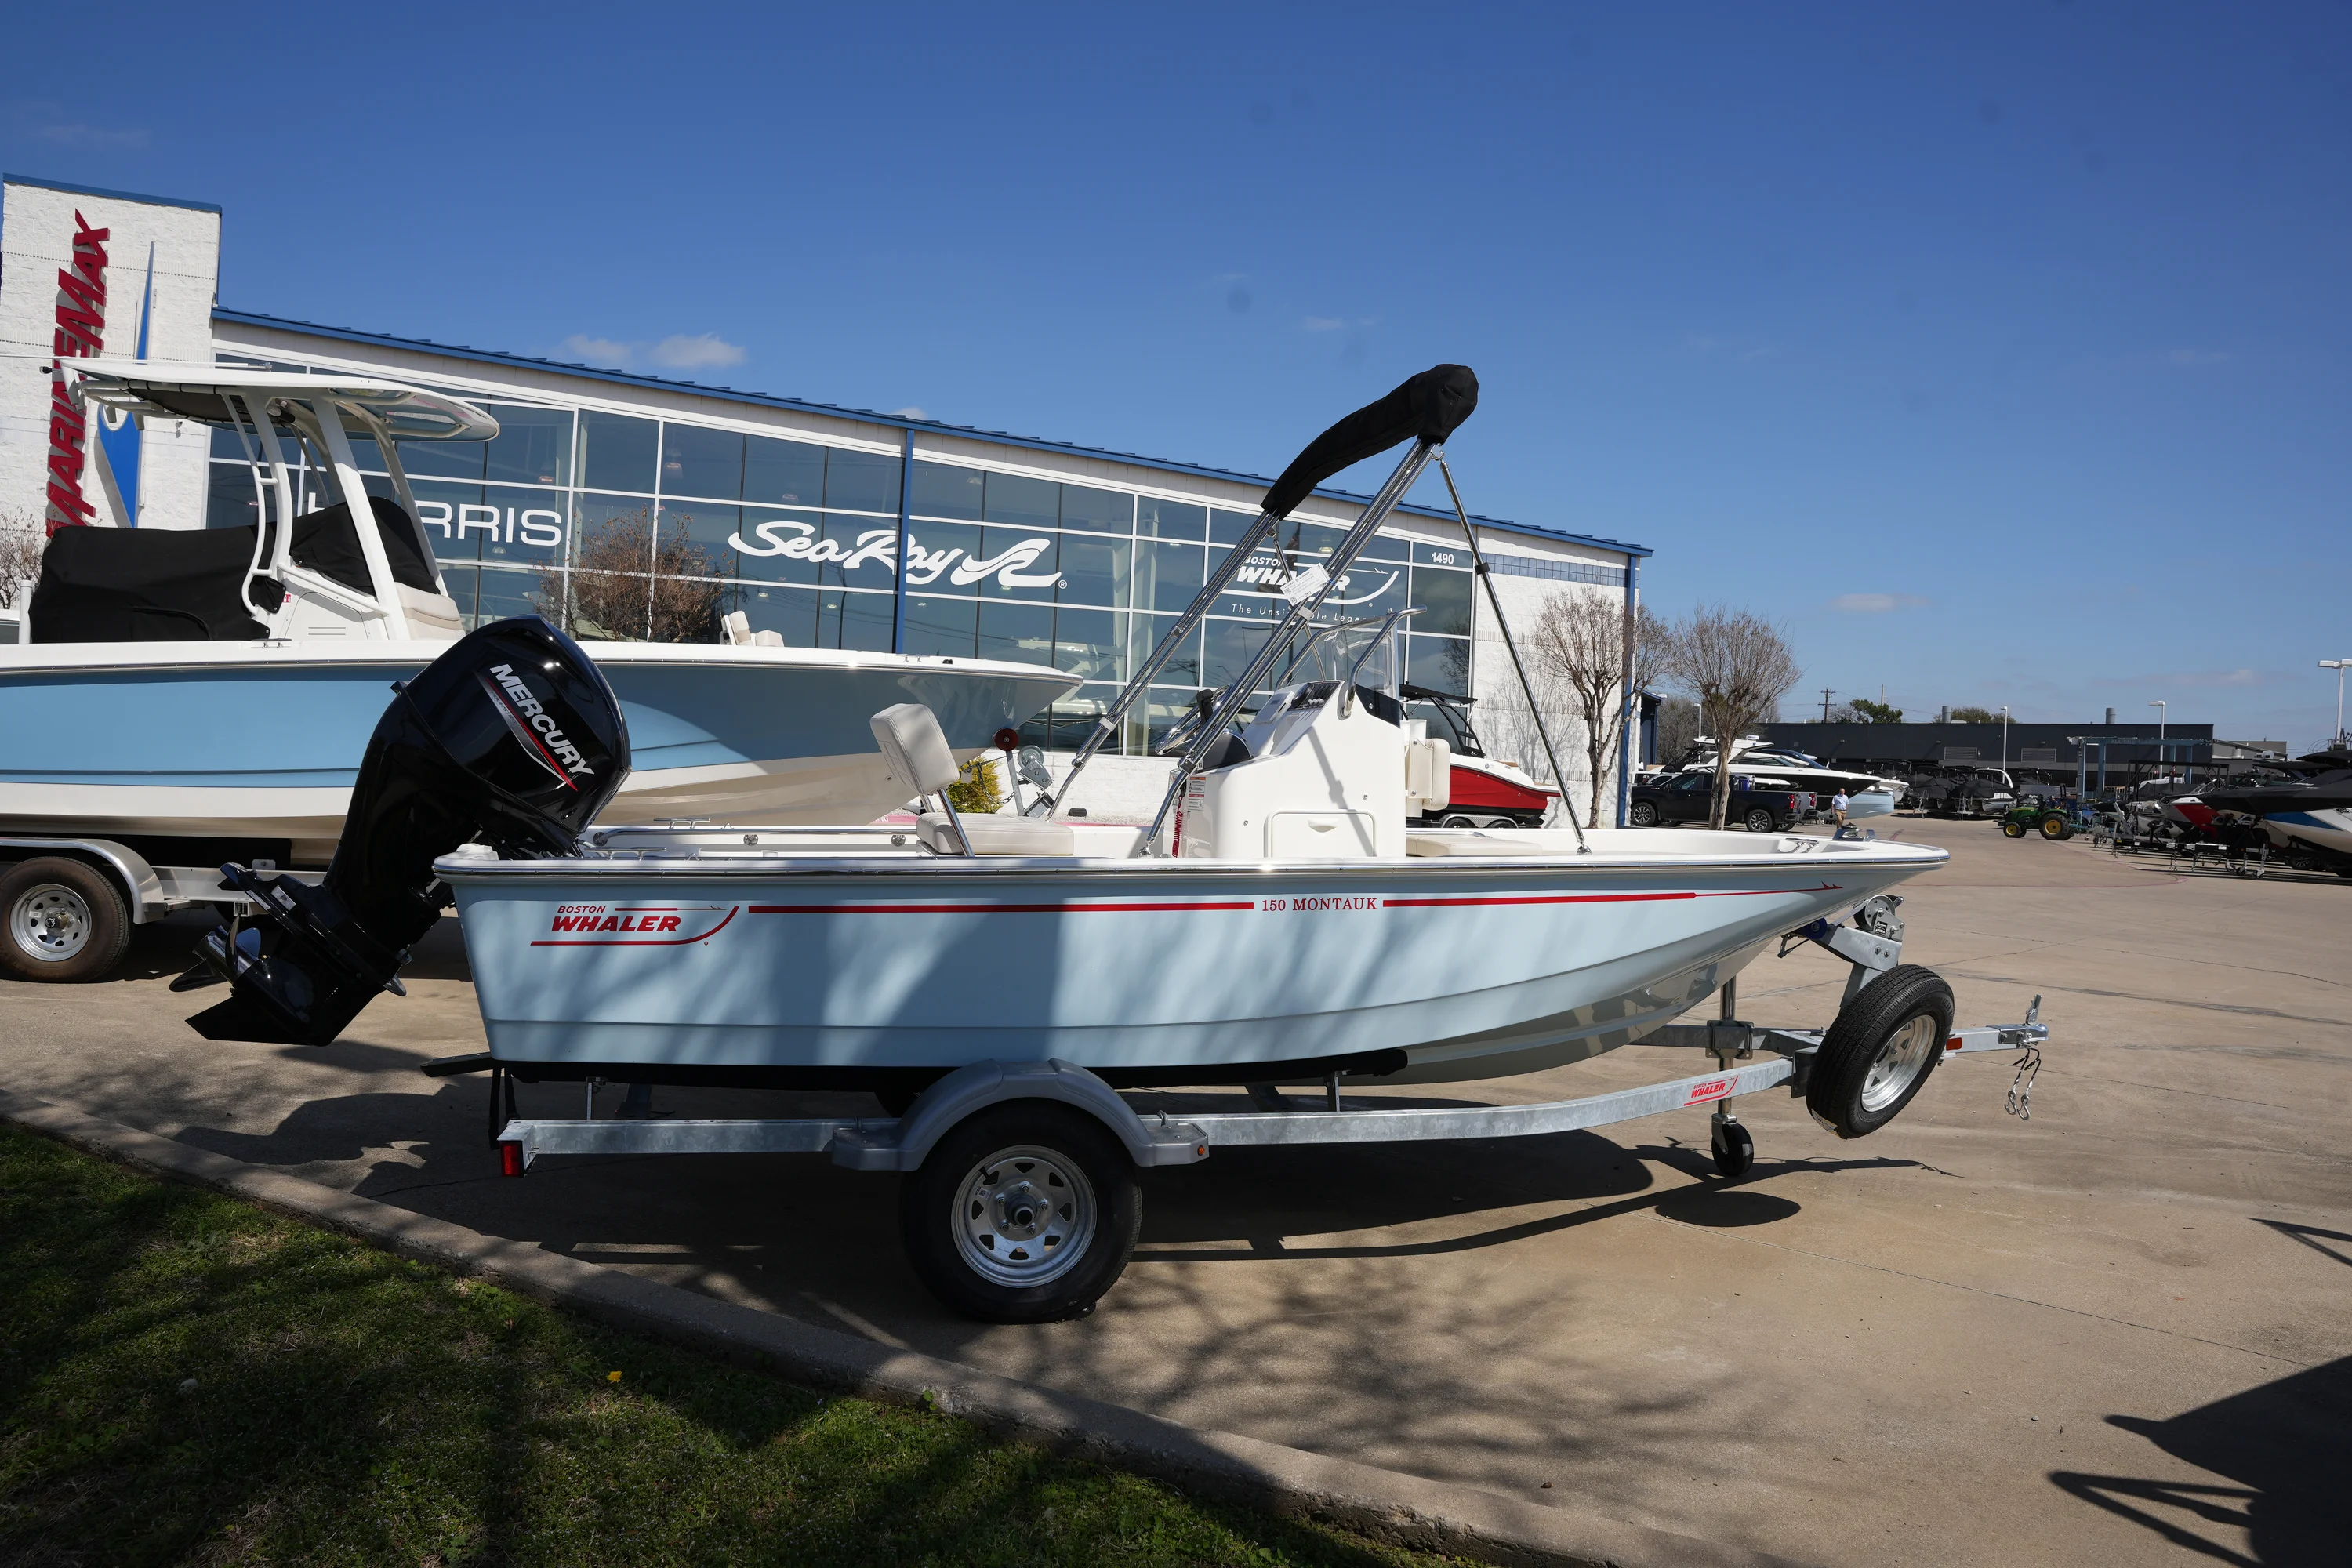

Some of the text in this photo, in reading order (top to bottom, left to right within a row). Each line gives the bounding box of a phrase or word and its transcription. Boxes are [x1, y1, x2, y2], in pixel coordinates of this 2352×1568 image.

[728, 521, 964, 585] Sea Ray
[1432, 552, 1454, 564] 1490
[1245, 556, 1287, 567] BOSTO
[1236, 565, 1351, 591] WHAR
[1232, 604, 1252, 614] The
[1259, 606, 1327, 621] Unsile
[489, 663, 594, 775] MERCURY
[1262, 898, 1377, 911] 150 MONTAUK
[551, 916, 681, 931] WHALER
[1691, 1083, 1726, 1098] WHALER
